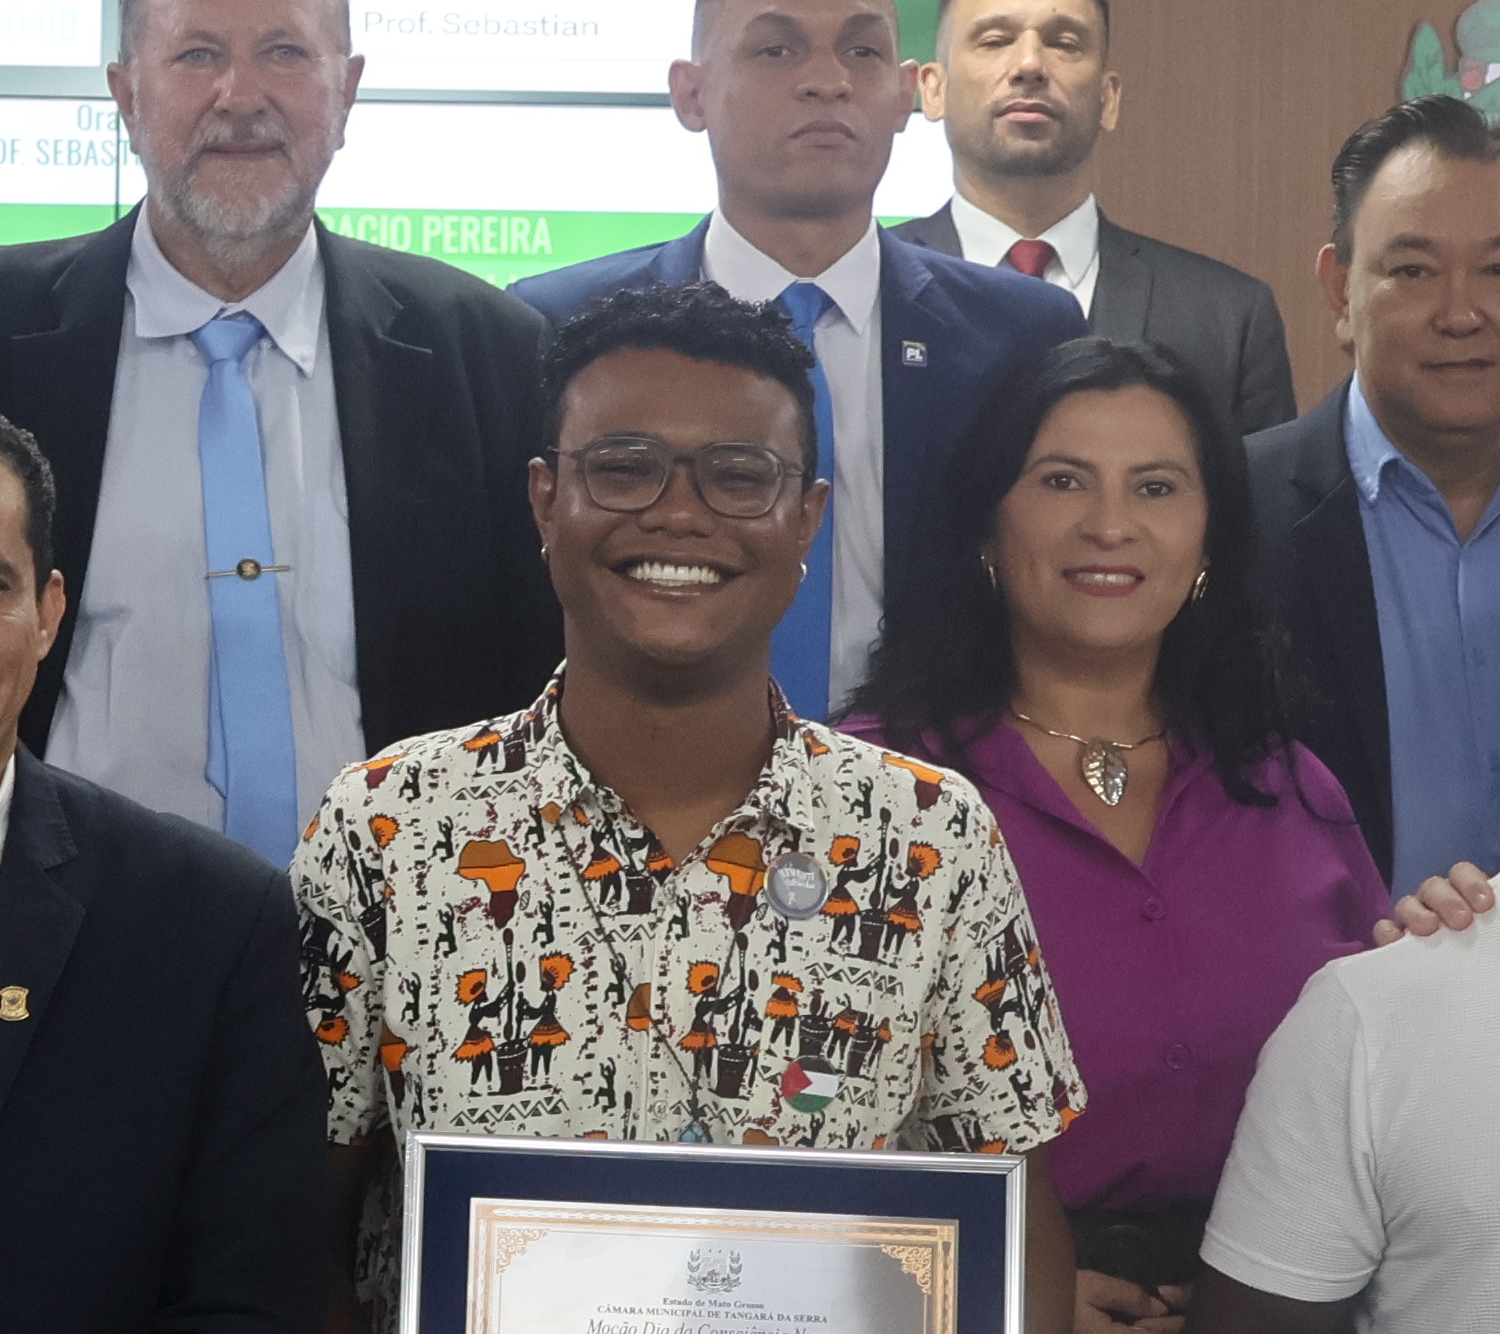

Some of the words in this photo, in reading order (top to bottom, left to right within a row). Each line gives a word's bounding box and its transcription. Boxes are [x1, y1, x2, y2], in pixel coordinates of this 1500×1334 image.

[363, 10, 432, 36] Prof.
[442, 11, 600, 39] Sebastian
[421, 214, 552, 255] PEREIRA
[597, 1304, 644, 1316] CÂMARA
[646, 1307, 705, 1318] MUNICIPAL
[707, 1310, 721, 1319] DE
[725, 1310, 775, 1321] TANGARÁ
[777, 1313, 791, 1323] DA
[793, 1314, 828, 1324] SERRA
[663, 1297, 693, 1307] Estado
[695, 1298, 705, 1307] de
[708, 1299, 731, 1309] Mato
[734, 1300, 765, 1310] Grosso
